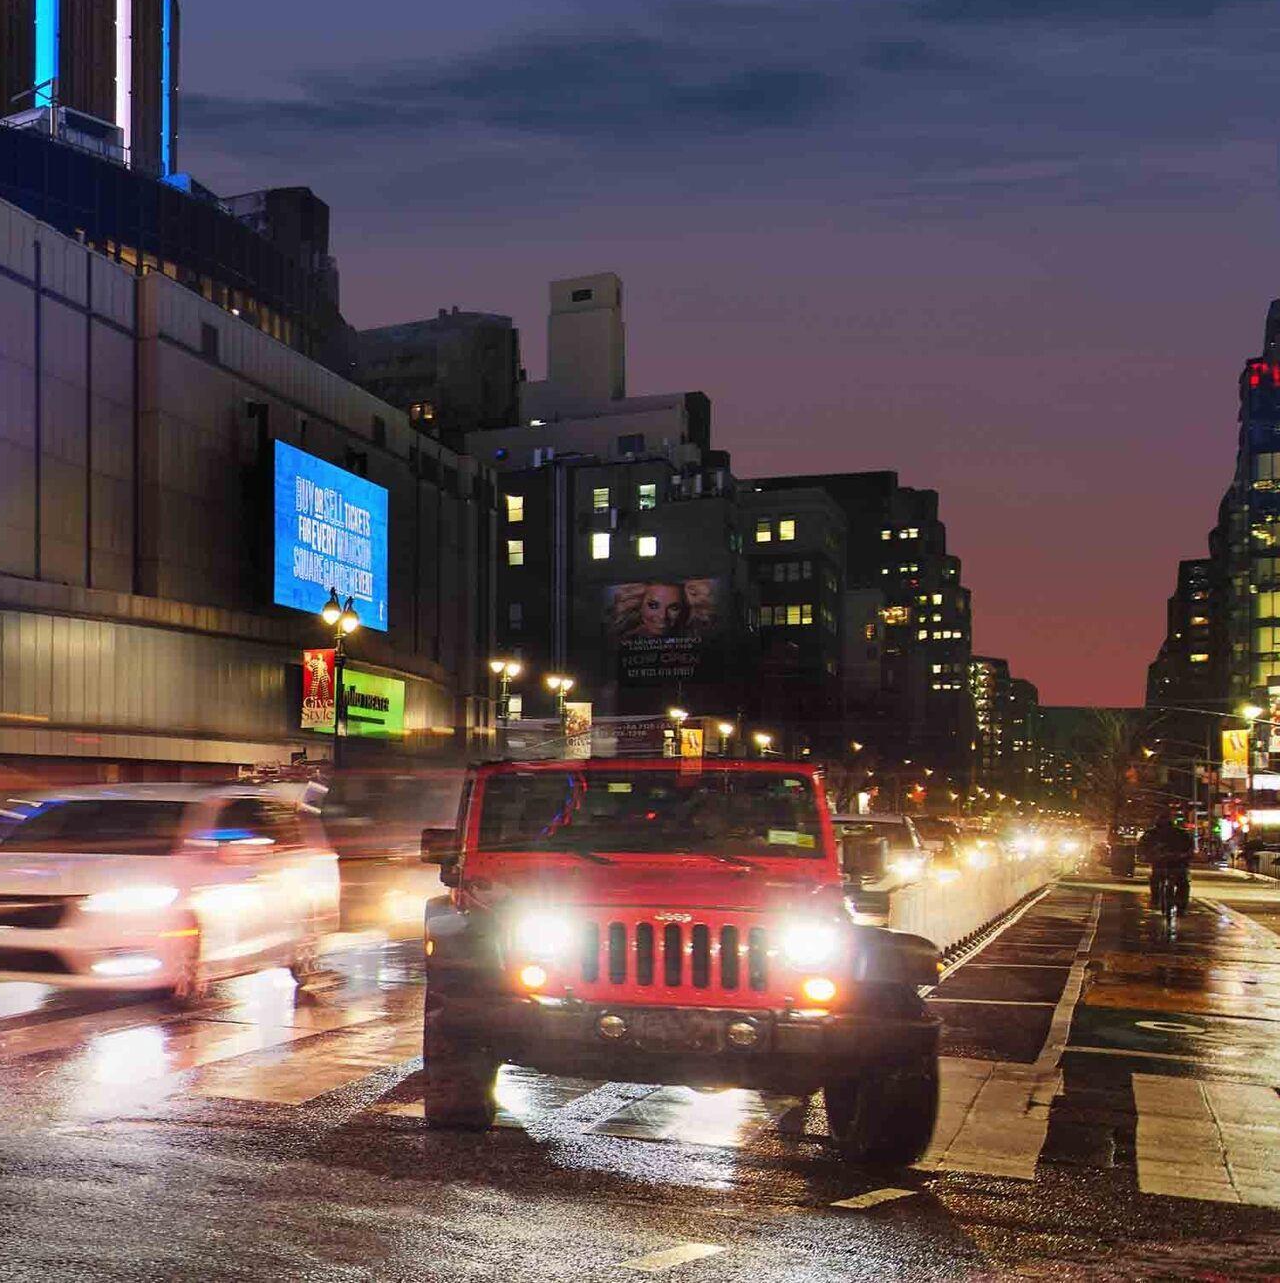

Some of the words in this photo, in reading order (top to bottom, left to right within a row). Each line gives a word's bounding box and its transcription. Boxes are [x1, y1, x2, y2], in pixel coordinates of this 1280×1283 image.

[296, 476, 315, 516] BUY
[324, 487, 345, 528] SELL
[345, 501, 371, 538] TICKETS
[298, 515, 312, 544] FOR
[312, 521, 336, 557] EVERY
[293, 545, 324, 585] SQUARE
[355, 567, 373, 596] EVENT
[301, 708, 333, 721] Style
[303, 696, 333, 710] Give
